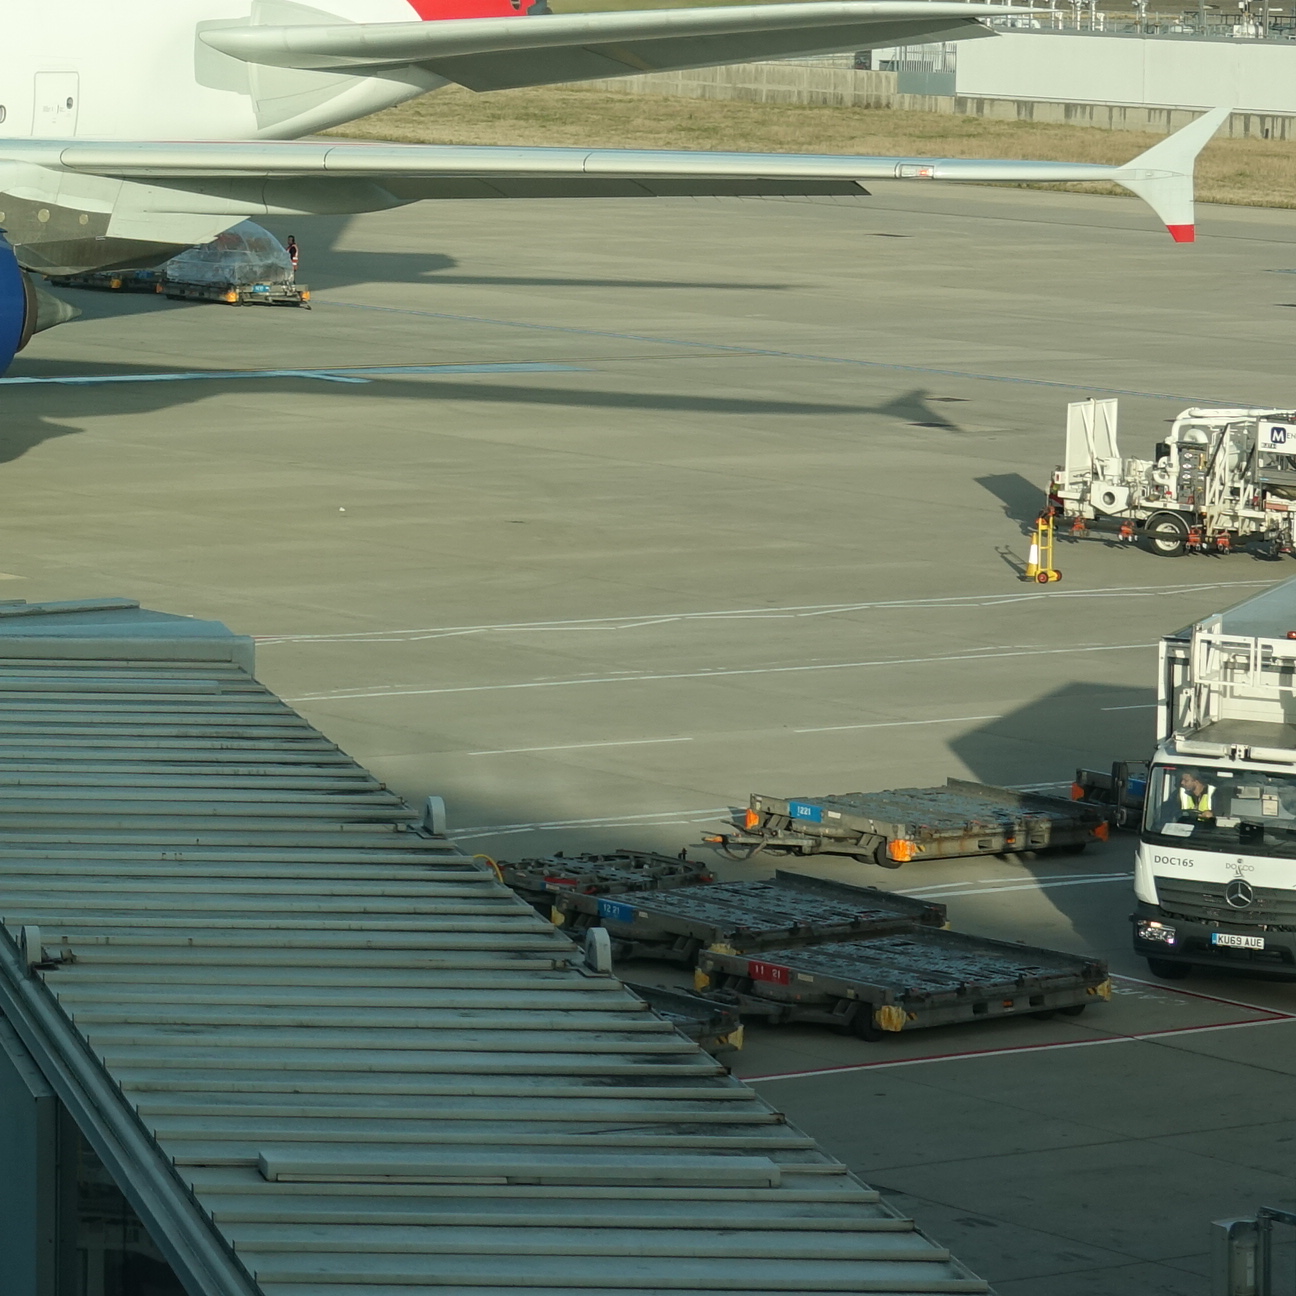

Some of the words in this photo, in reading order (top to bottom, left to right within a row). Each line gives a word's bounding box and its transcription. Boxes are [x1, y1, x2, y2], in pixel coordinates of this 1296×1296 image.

[1154, 855, 1194, 867] DOC165
[1218, 935, 1242, 946] KU69
[1244, 938, 1262, 947] AUE
